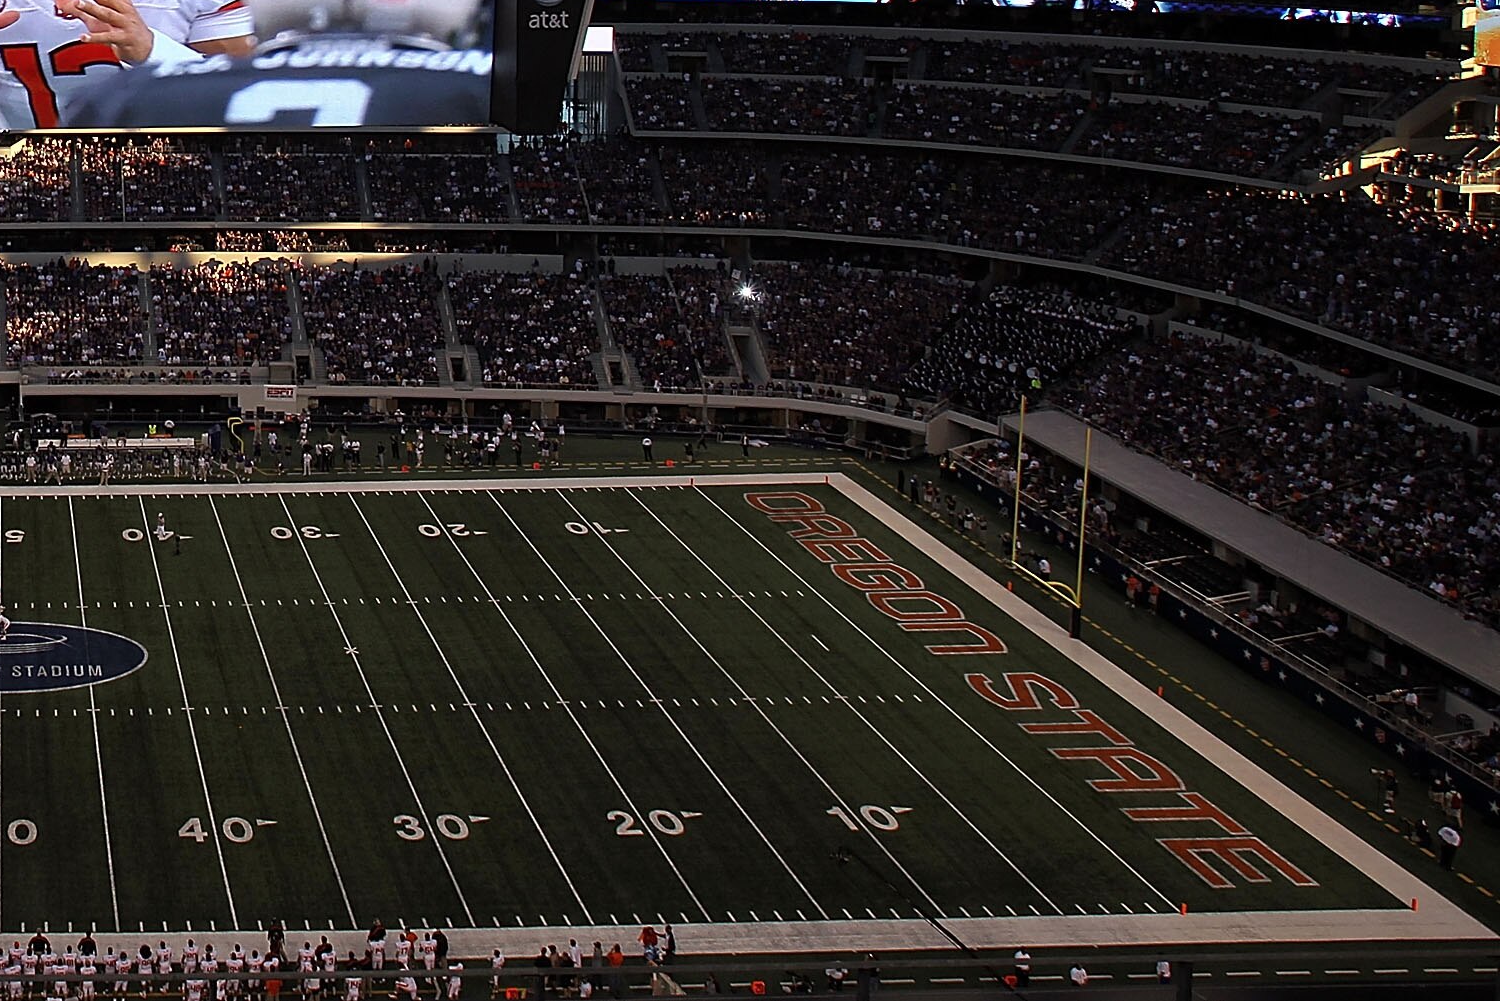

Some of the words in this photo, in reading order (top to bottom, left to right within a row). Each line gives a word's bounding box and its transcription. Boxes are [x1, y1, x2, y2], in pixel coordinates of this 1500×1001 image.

[528, 10, 569, 29] at&t
[11, 663, 104, 678] STADIUM
[743, 491, 1008, 655] OREGON
[963, 671, 1320, 889] STATE
[178, 816, 254, 843] 40
[393, 814, 469, 841] 30
[606, 809, 685, 836] 20
[826, 804, 899, 831] 10
